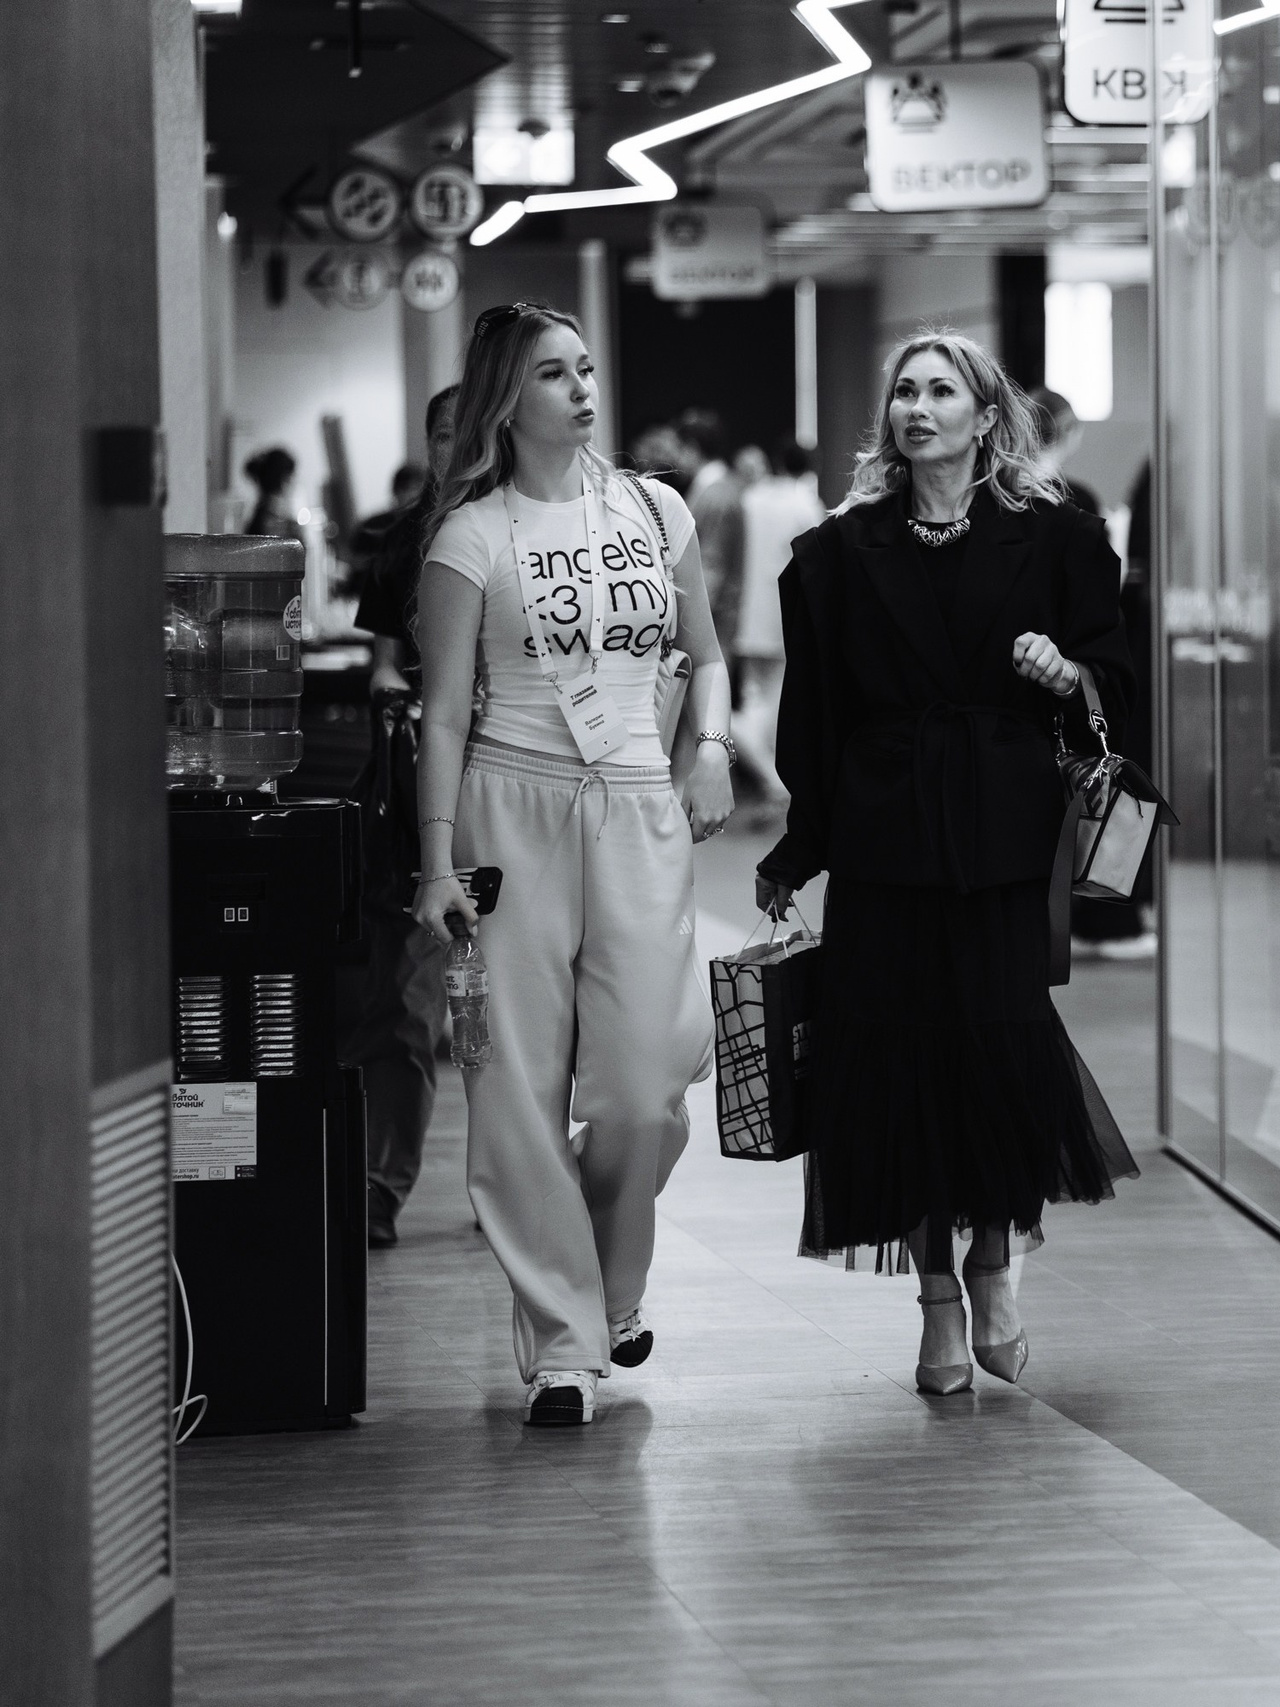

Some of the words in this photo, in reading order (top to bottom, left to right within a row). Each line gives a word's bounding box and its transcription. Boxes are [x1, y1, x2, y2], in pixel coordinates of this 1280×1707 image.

[528, 531, 655, 585] angels
[608, 579, 668, 619] my
[523, 624, 665, 658] swag
